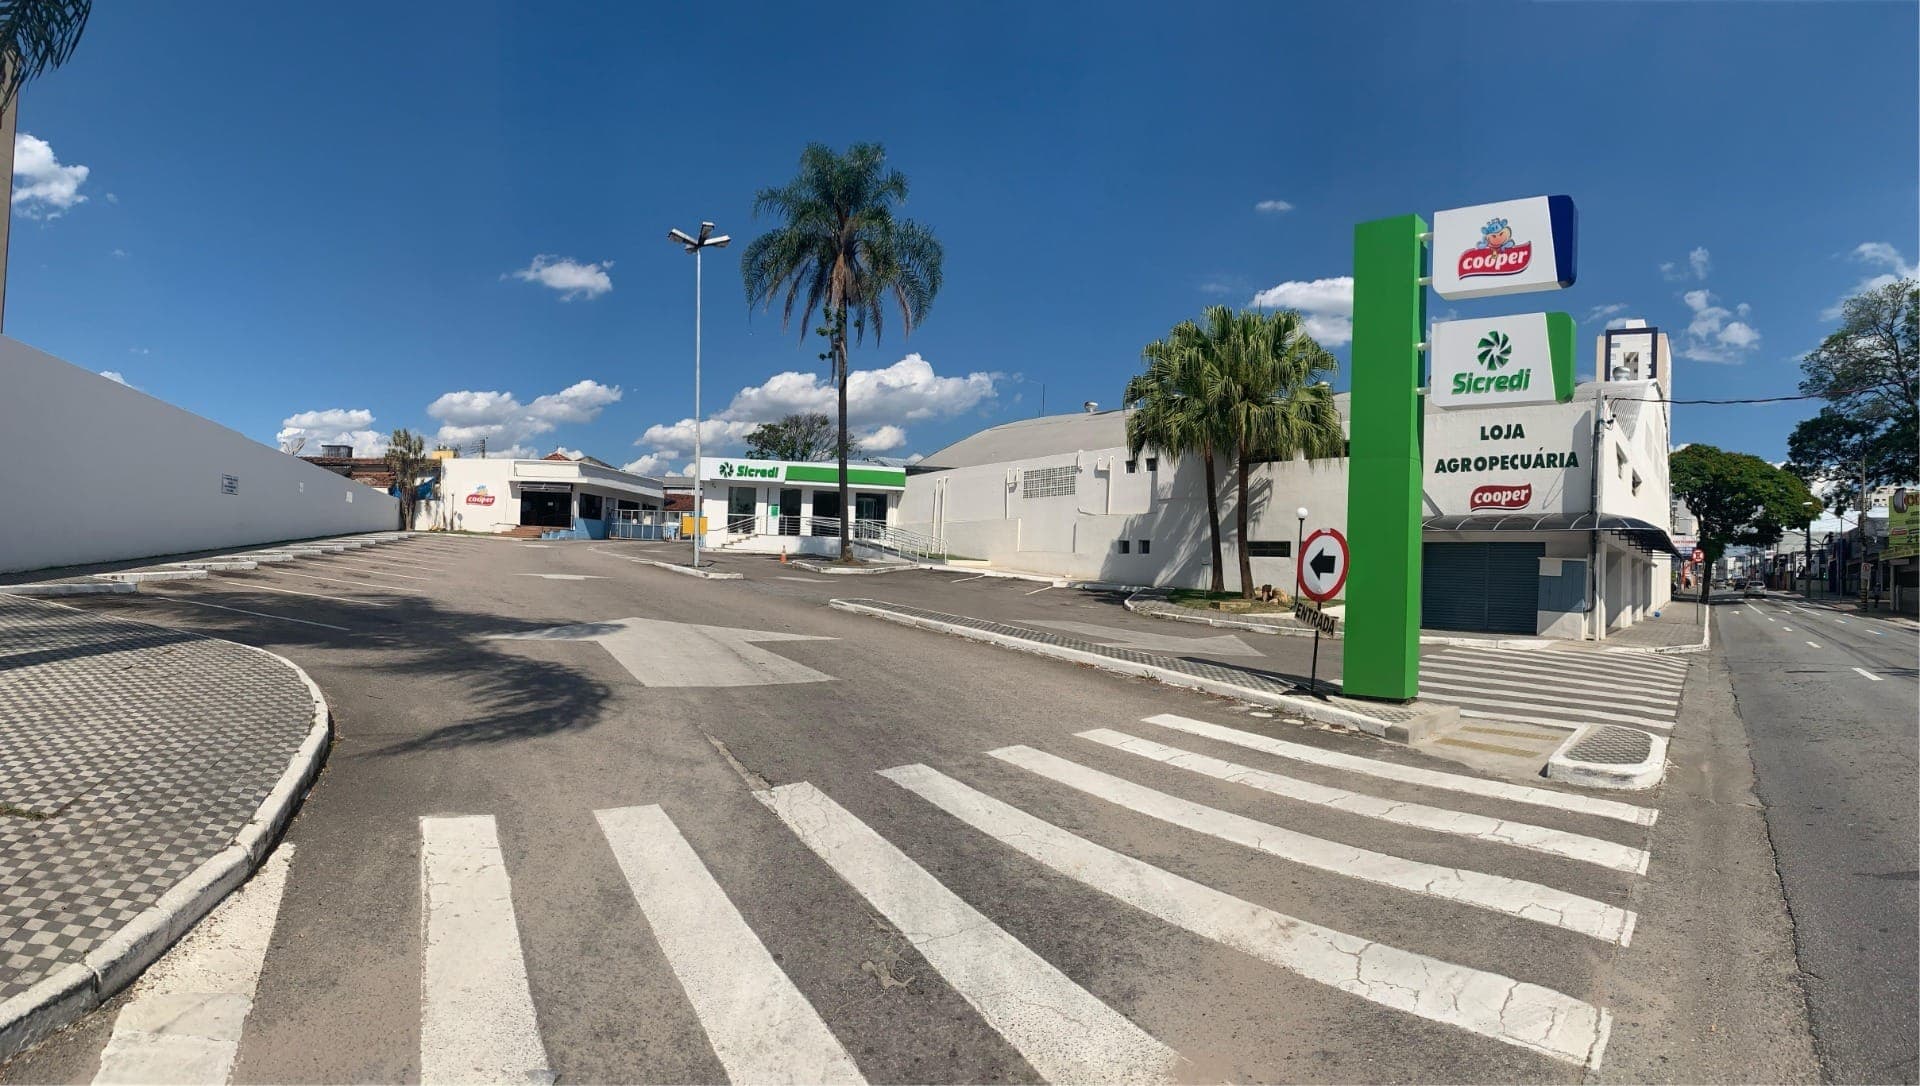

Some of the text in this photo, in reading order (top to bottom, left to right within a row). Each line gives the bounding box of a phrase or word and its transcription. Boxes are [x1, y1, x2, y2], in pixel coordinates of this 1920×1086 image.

[1463, 249, 1529, 271] cooper
[1451, 369, 1531, 394] Sicredi
[1480, 424, 1525, 441] LOJA
[1434, 447, 1579, 474] AGROPECUÁRIA
[737, 465, 778, 478] Sicredi
[468, 496, 493, 504] cooper
[1475, 489, 1529, 506] cooper
[1294, 603, 1335, 636] ENTRADA
